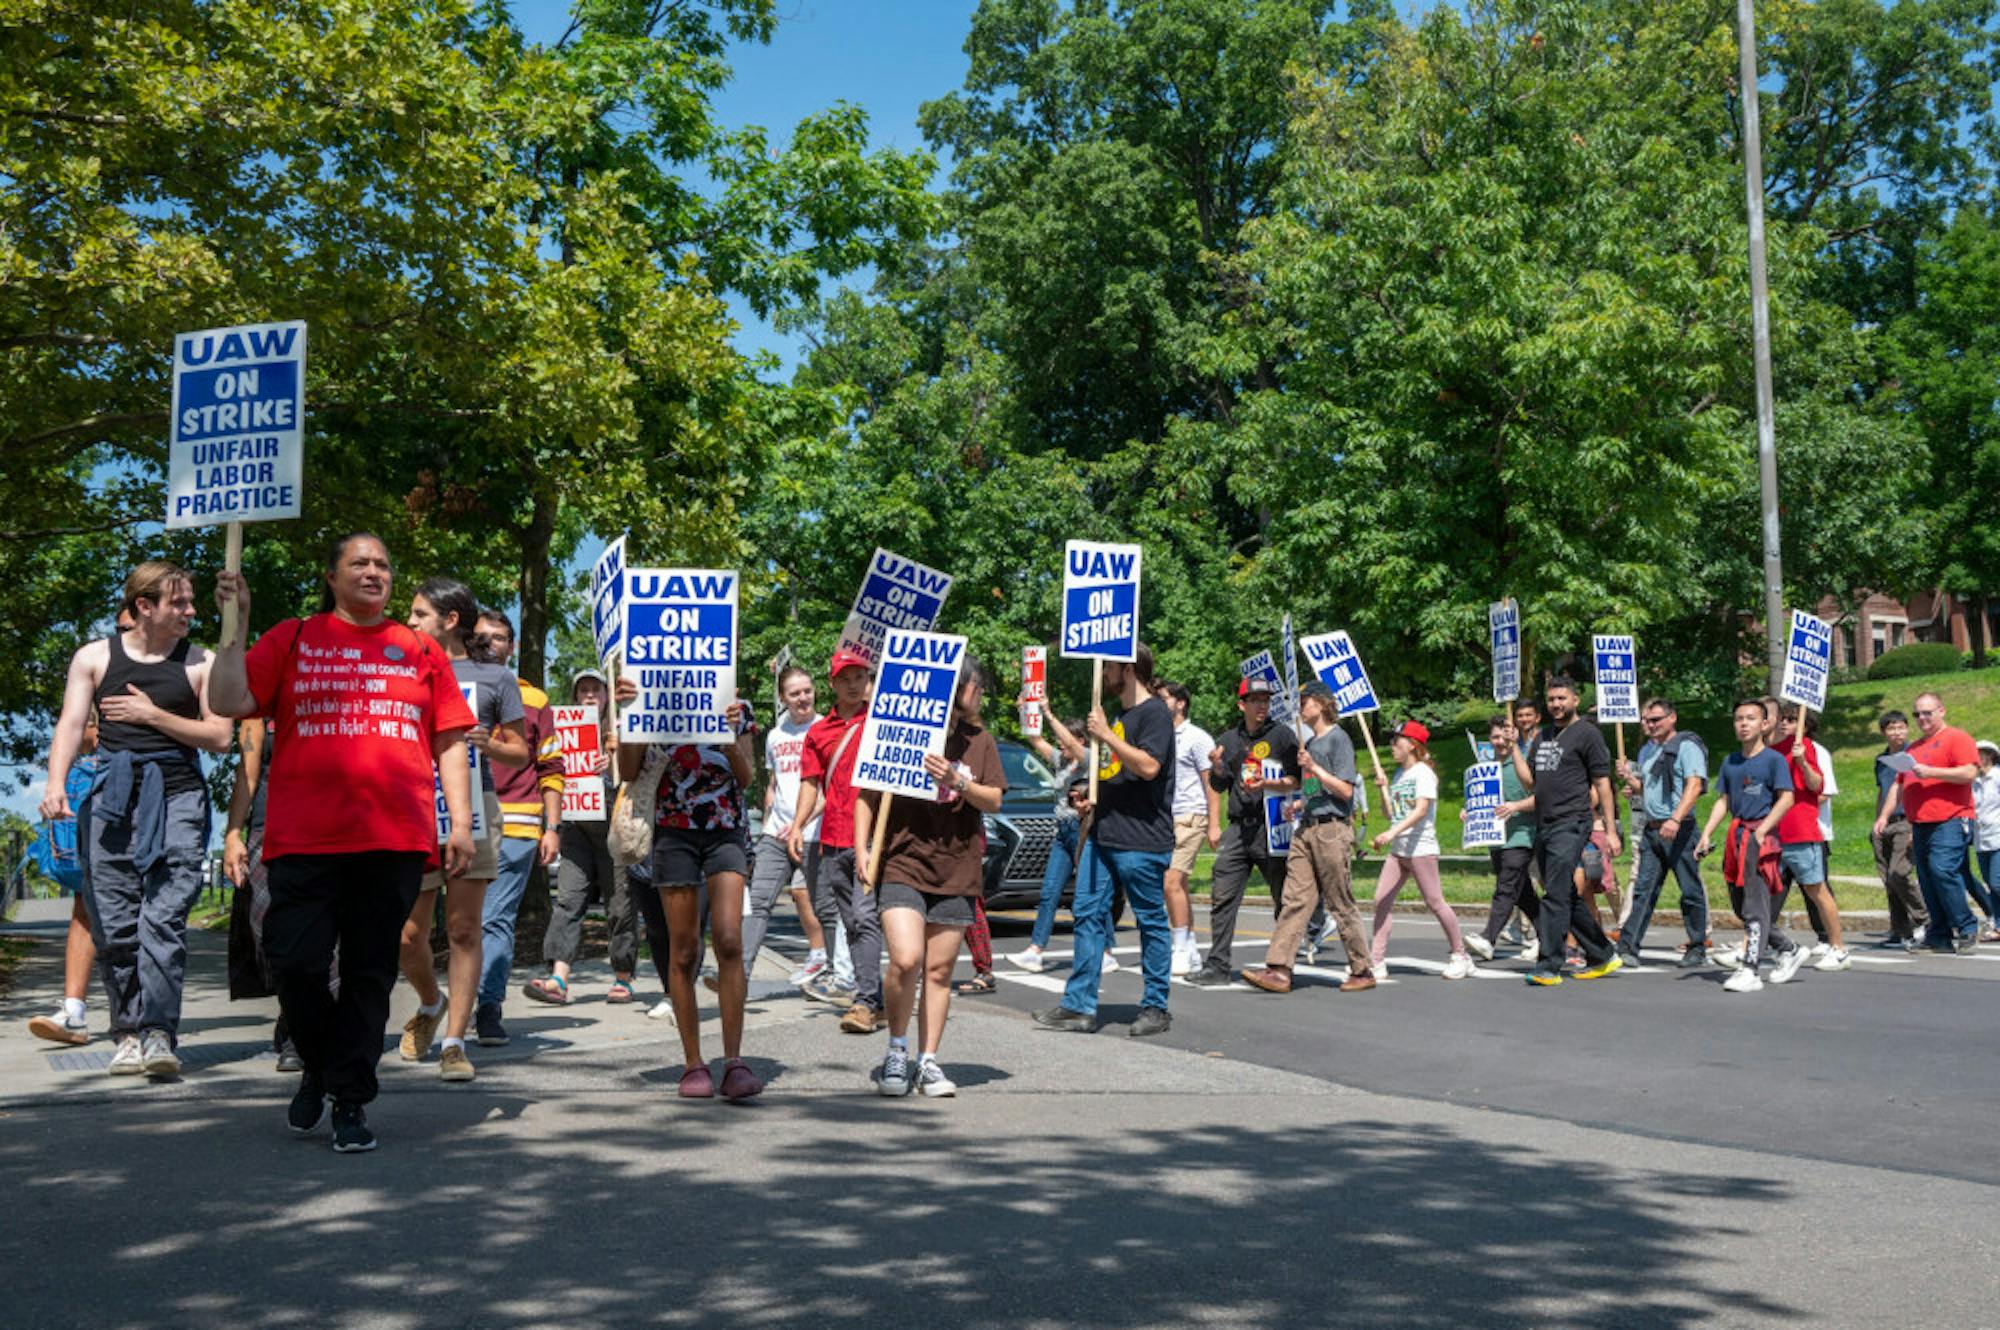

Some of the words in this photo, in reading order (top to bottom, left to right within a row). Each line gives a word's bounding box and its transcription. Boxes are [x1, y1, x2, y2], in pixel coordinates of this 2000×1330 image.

[182, 328, 298, 366] UAW
[215, 369, 259, 399] ON
[181, 400, 293, 435] STRIKE
[192, 437, 279, 465] UNFAIR
[196, 462, 274, 490] LABOR
[176, 486, 293, 517] PRACTICE
[592, 546, 620, 597] UAW
[876, 554, 949, 594] UAW
[1070, 550, 1135, 580] UAW
[631, 576, 733, 599] UAW
[887, 586, 917, 610] ON
[860, 596, 929, 631] STRIKE
[1088, 589, 1114, 617] ON
[659, 608, 699, 633] ON
[1067, 613, 1132, 649] STRIKE
[1796, 614, 1831, 638] UAW
[629, 636, 728, 661] STRIKE
[842, 640, 880, 664] PRAC
[858, 634, 884, 653] LAB
[888, 636, 962, 664] UAW
[1307, 638, 1350, 661] UAW
[1596, 638, 1631, 650] UAW
[1241, 654, 1269, 675] UAW
[641, 670, 716, 688] UNFAIR
[901, 669, 931, 693] ON
[369, 699, 392, 715] SHUT
[393, 700, 403, 717] IT
[644, 692, 712, 710] LABOR
[875, 692, 947, 724] STRIKE
[556, 709, 584, 721] AW
[628, 714, 728, 732] PRACTICE
[379, 720, 399, 737] WE
[876, 724, 931, 748] UNFAIR
[874, 744, 924, 767] LABOR
[858, 762, 934, 791] PRACTICE
